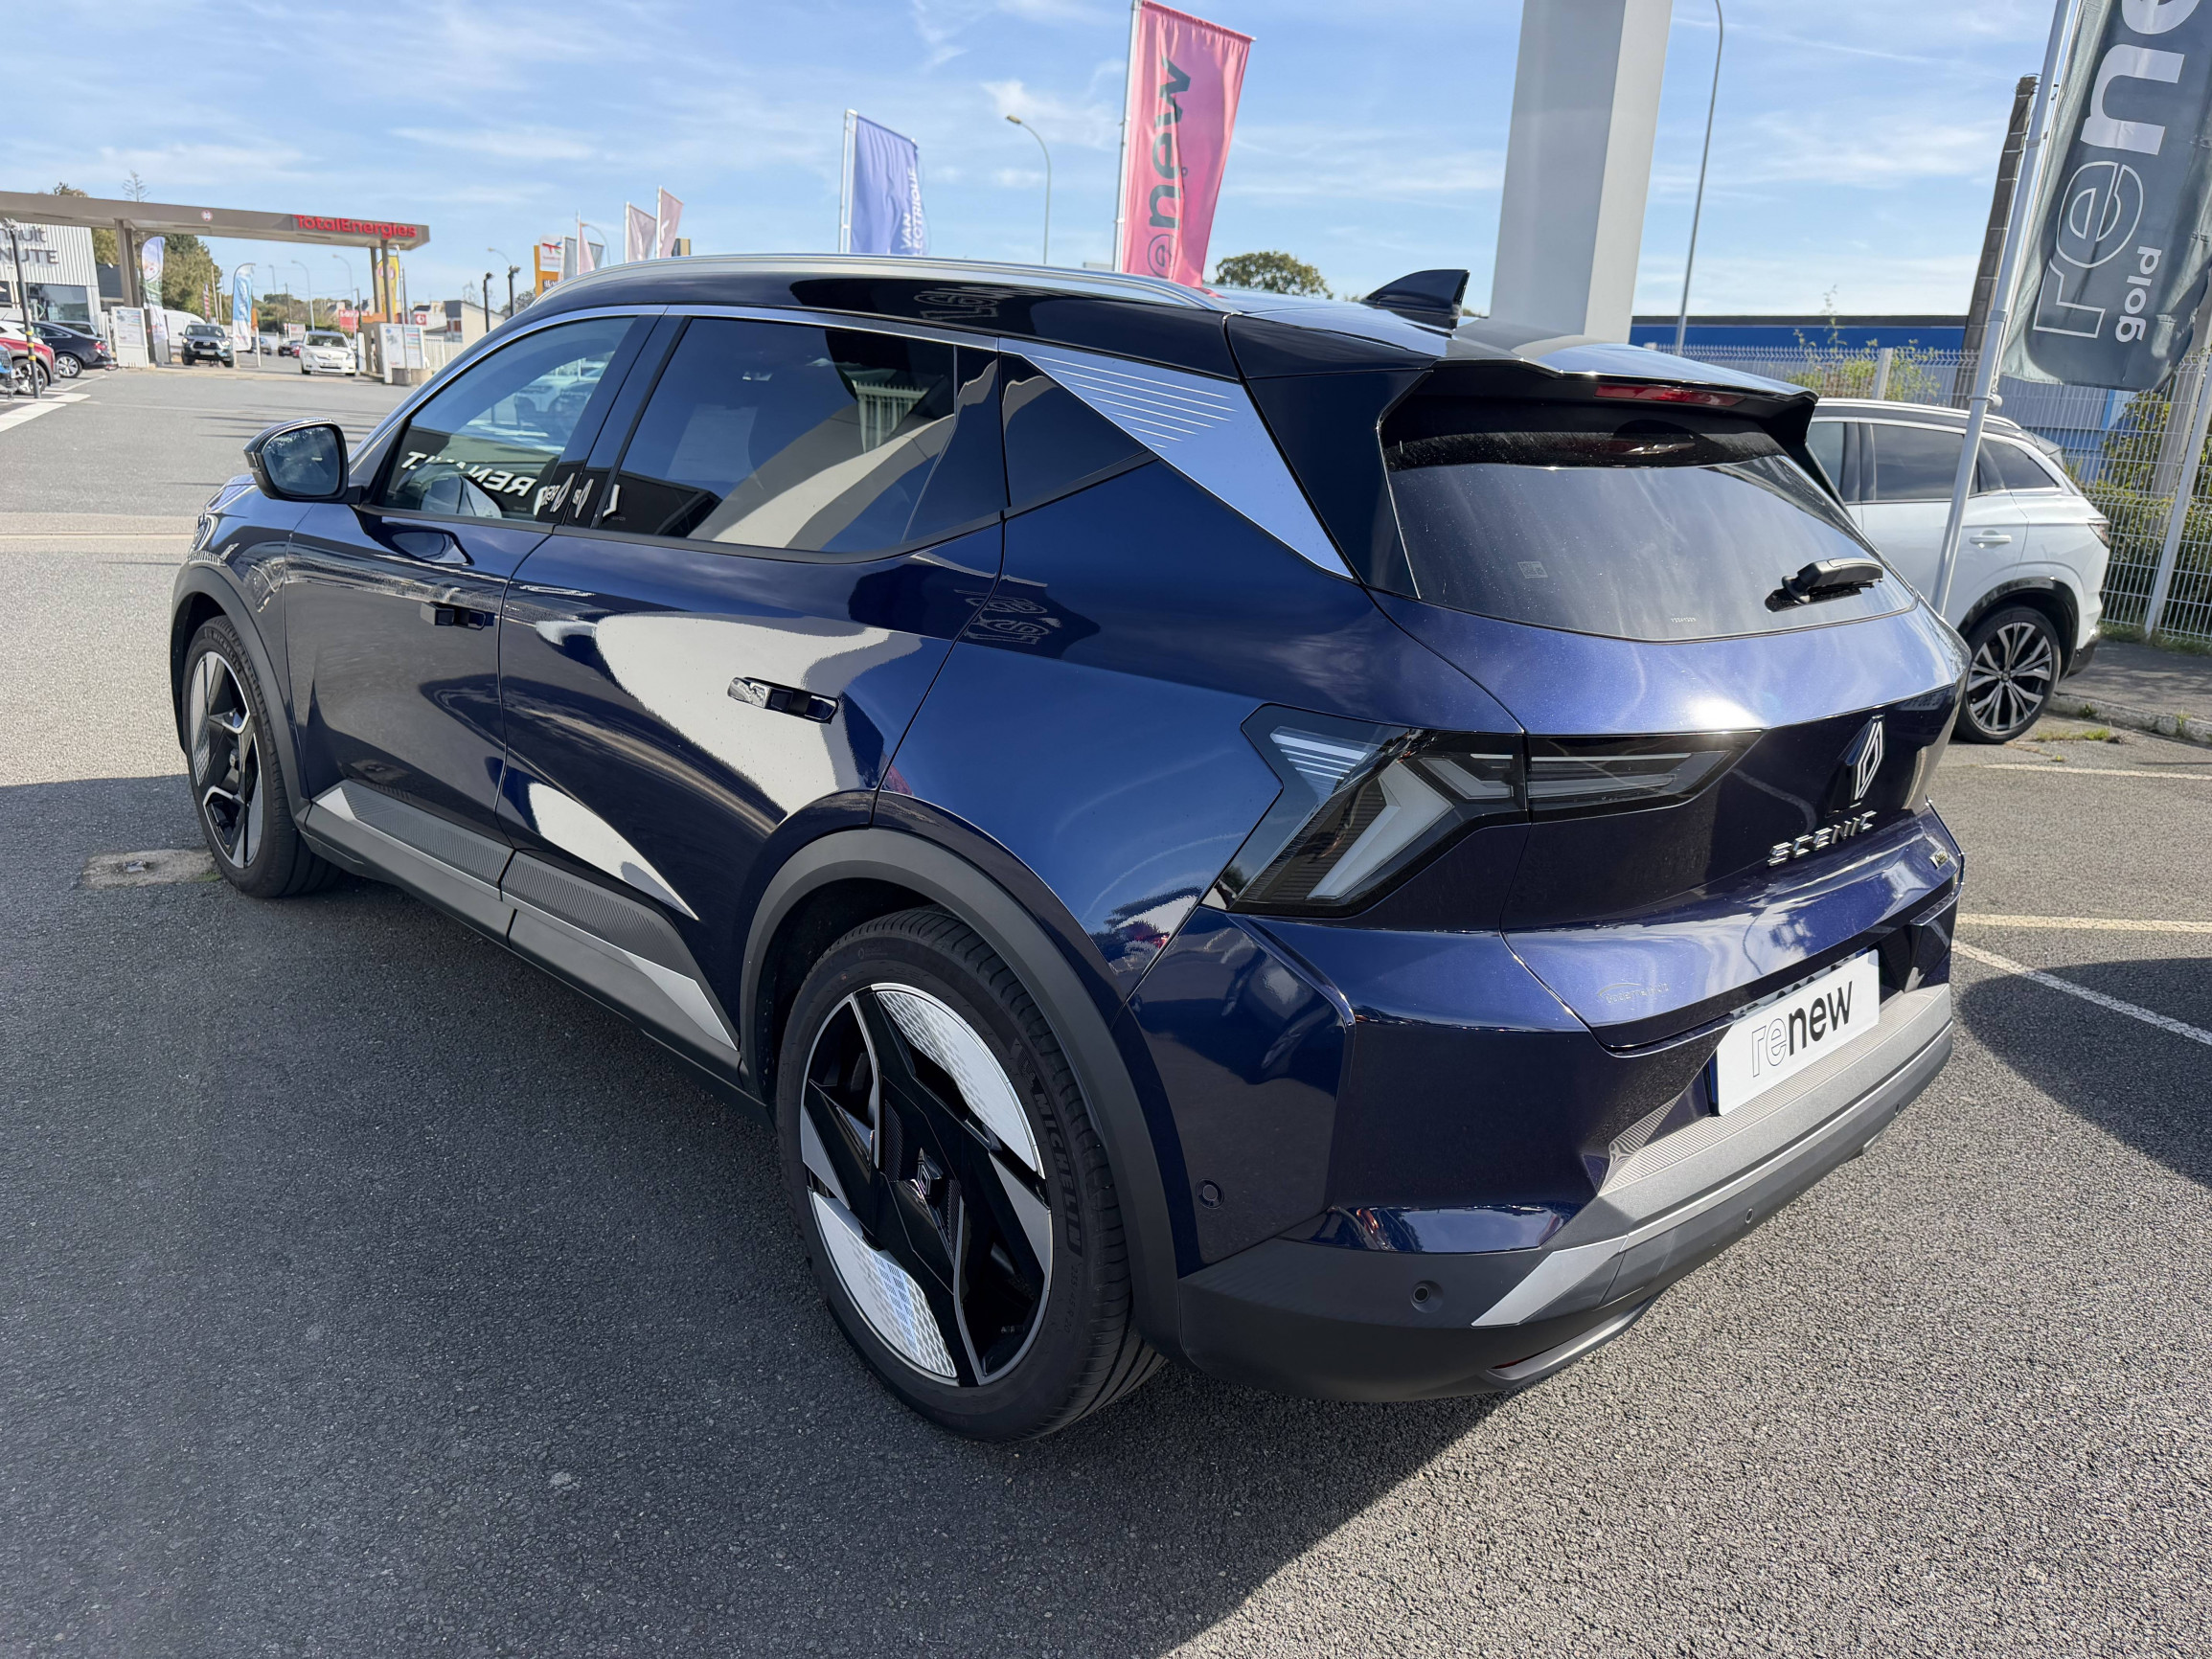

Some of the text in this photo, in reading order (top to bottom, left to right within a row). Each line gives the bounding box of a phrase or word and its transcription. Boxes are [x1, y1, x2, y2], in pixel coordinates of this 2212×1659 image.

[293, 215, 418, 239] TotalEnergies
[900, 212, 911, 249] VAN
[2114, 245, 2162, 343] gold
[1767, 810, 1878, 867] SCENIC
[1751, 980, 1853, 1078] renew
[1035, 1092, 1082, 1246] MICHELIN
